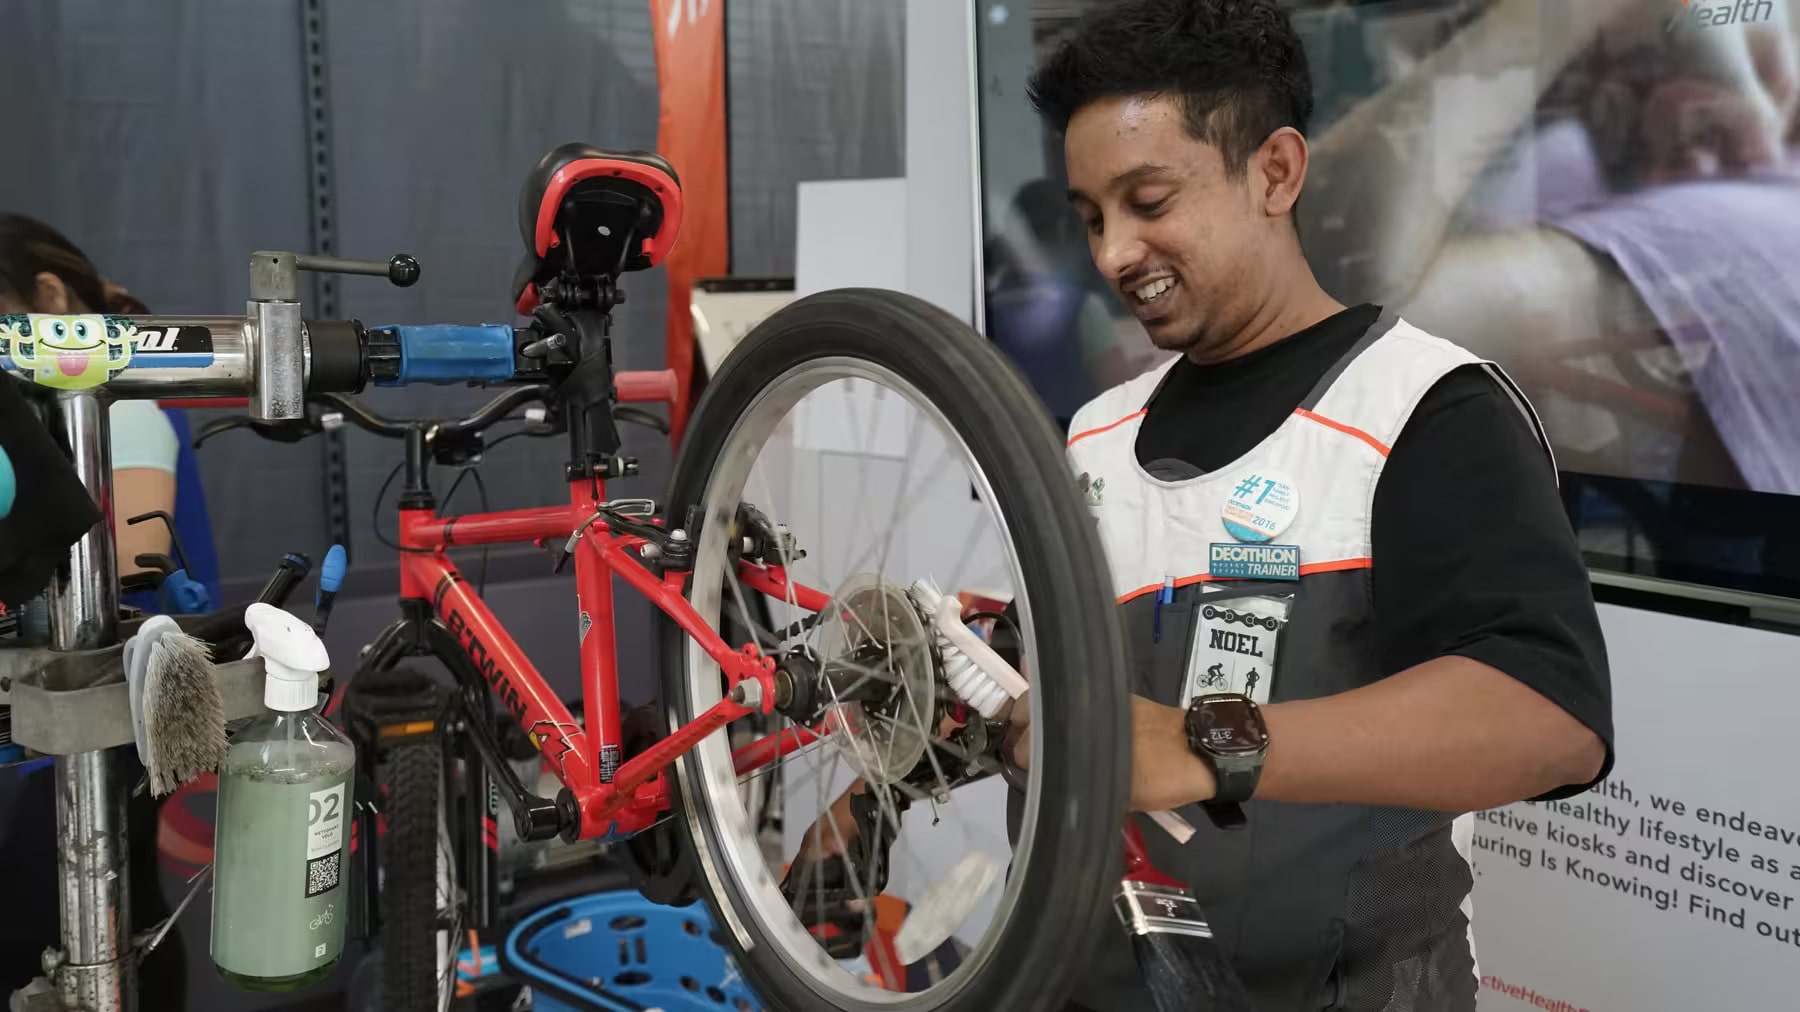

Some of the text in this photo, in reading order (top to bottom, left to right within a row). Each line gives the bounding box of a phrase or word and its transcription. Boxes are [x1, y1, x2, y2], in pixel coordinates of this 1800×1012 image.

[1233, 474, 1277, 505] #1
[1252, 515, 1277, 531] 2016
[1211, 546, 1297, 564] DECATHLON
[1247, 563, 1297, 577] TRAINER
[1208, 627, 1264, 659] NOEL
[1650, 793, 1686, 817] we
[1696, 807, 1800, 847] endeav
[1476, 809, 1794, 911] active kiosks and discover
[1640, 816, 1740, 862] lifestyle
[1751, 853, 1779, 874] as
[1541, 848, 1557, 871] Is
[1566, 856, 1678, 911] Knowing!
[1690, 894, 1745, 930] Find
[1756, 920, 1800, 948] out
